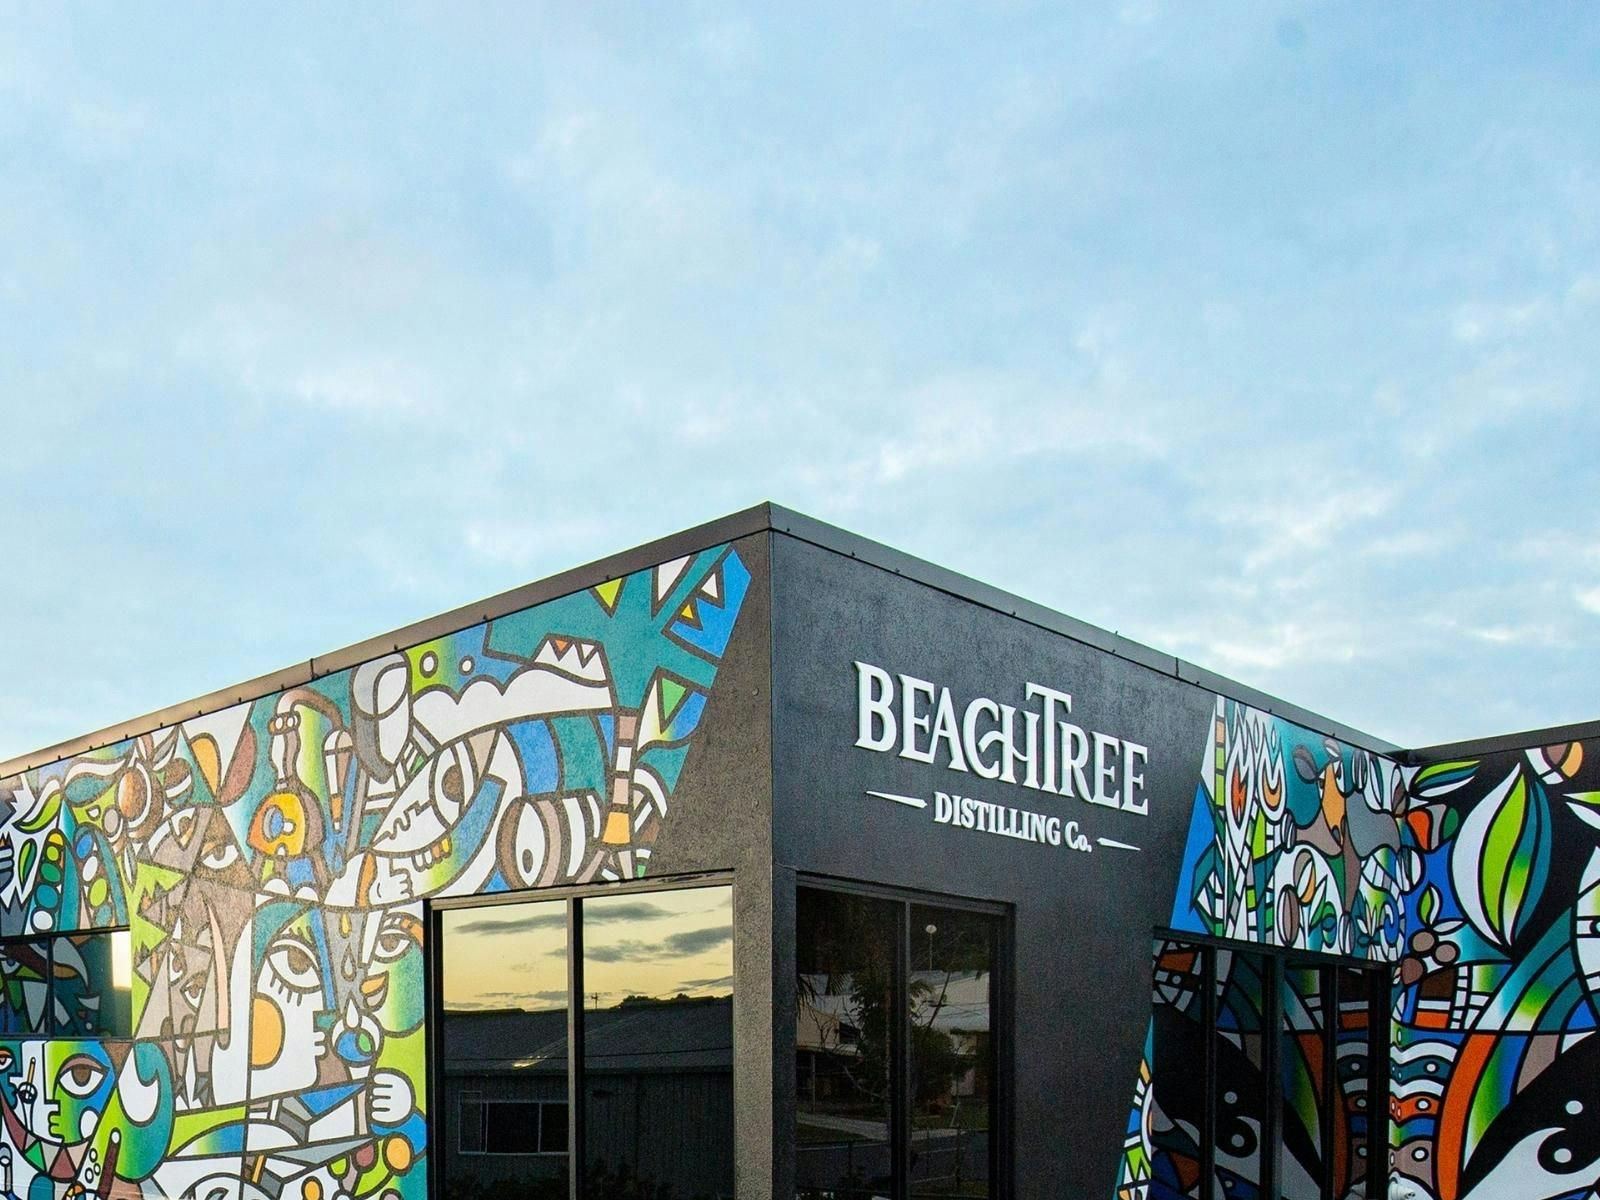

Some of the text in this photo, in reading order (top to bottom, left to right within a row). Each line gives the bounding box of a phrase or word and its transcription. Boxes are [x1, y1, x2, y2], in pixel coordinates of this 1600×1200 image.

[854, 661, 1148, 816] BEACHTREE
[934, 791, 1092, 852] DISTILLING Co.
